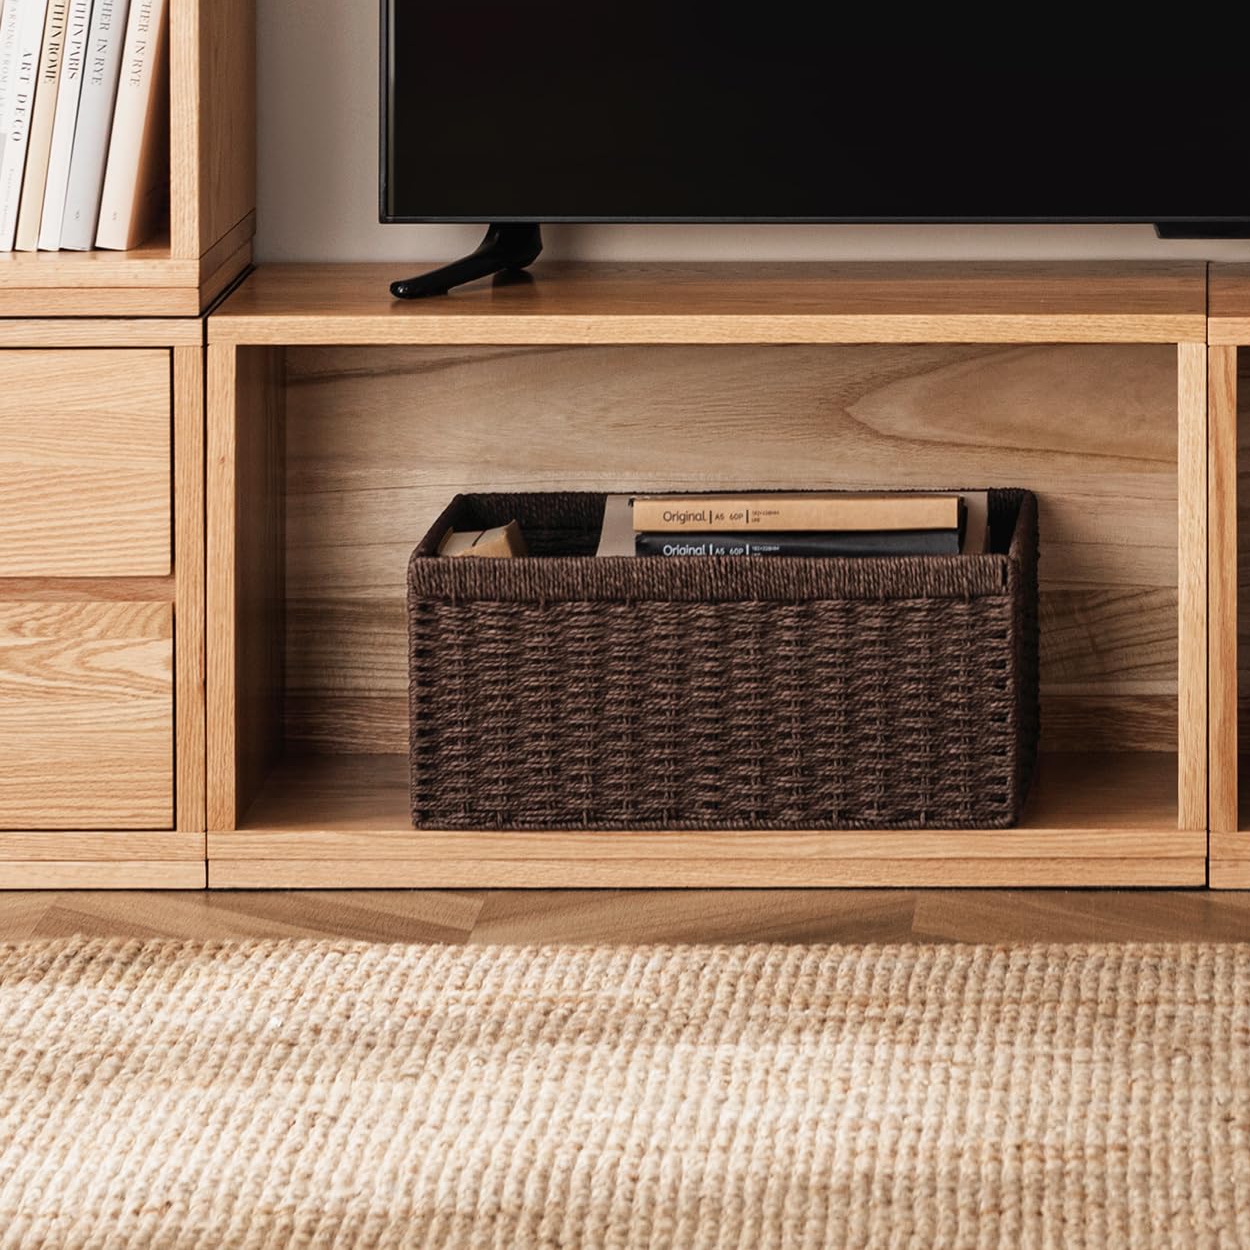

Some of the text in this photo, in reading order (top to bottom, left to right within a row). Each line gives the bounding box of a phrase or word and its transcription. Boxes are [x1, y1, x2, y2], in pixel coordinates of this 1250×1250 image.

[51, 25, 63, 39] IN
[73, 23, 84, 38] IN
[97, 38, 108, 53] IN
[135, 40, 146, 54] IN
[20, 50, 32, 82] ART
[44, 43, 60, 84] ROME
[68, 40, 82, 79] PARIS
[91, 57, 105, 85] RYE
[130, 59, 143, 86] RYE
[11, 93, 28, 142] DECO
[662, 511, 706, 524] Original
[662, 543, 706, 557] Original
